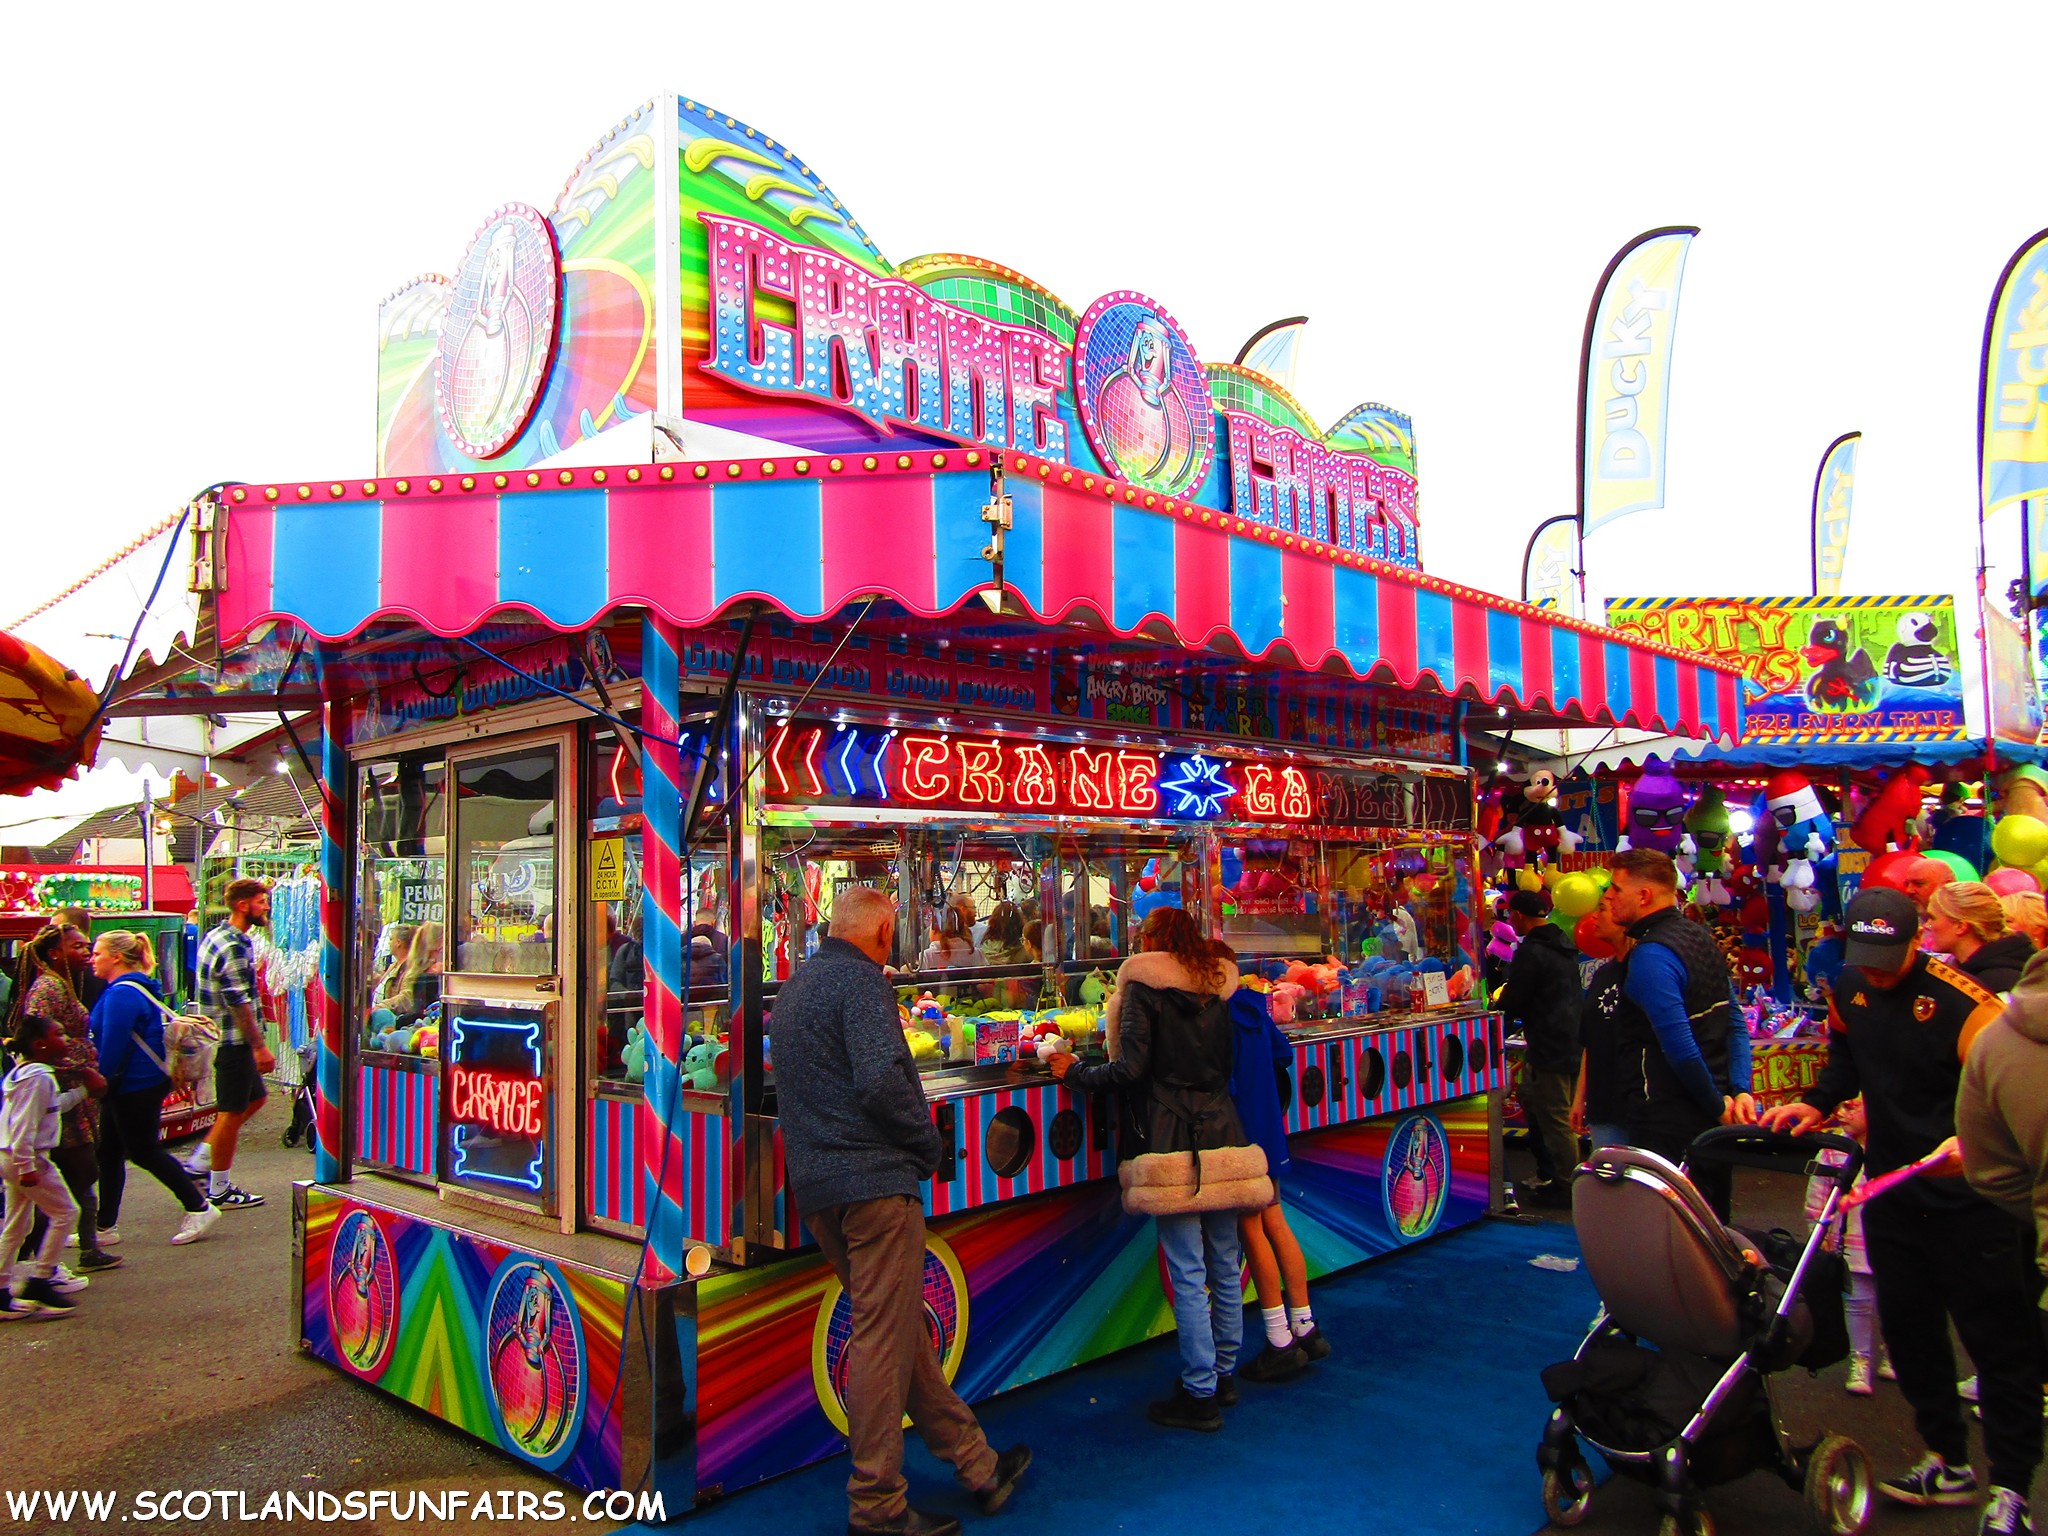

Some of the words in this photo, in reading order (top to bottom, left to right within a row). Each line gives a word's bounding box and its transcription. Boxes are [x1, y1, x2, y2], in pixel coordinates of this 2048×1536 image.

[698, 212, 1072, 465] CRANE
[1223, 409, 1421, 570] GAMES
[682, 627, 764, 675] CASH
[770, 637, 871, 690] PRIZES
[885, 653, 950, 697] CASH
[956, 662, 1035, 707] PRIZES
[1086, 675, 1128, 701] ANGRY
[1130, 682, 1168, 706] BIRDS
[1106, 702, 1150, 725] SPACE
[1206, 708, 1275, 739] MARIO
[1797, 711, 1881, 736] EVERY
[902, 737, 1158, 811] CRANE
[404, 884, 443, 901] PENA
[1851, 920, 1895, 935] ellesse
[978, 1024, 990, 1045] 3
[997, 1044, 1017, 1063] £1
[452, 1069, 543, 1135] CHANGE
[190, 1112, 217, 1132] PLEASE
